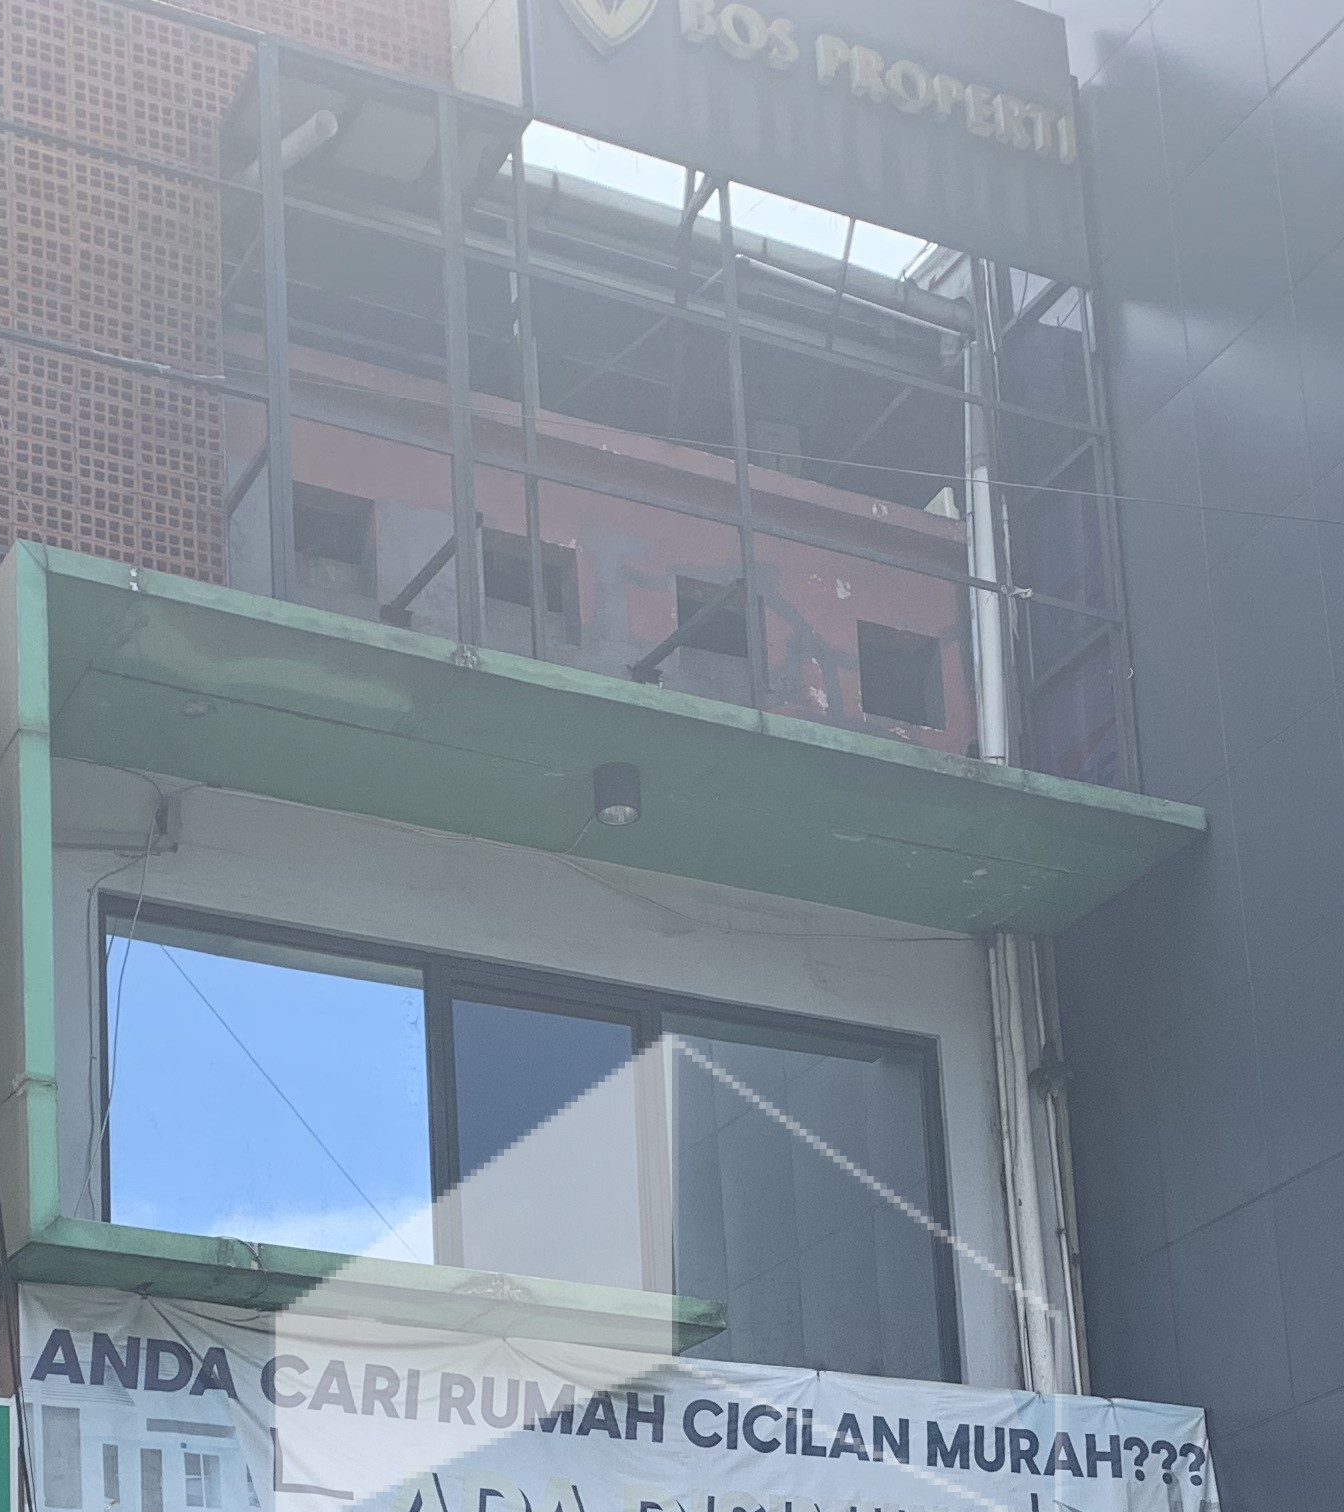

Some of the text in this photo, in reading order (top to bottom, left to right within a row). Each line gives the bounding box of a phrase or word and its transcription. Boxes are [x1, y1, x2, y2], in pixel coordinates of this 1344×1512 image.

[679, 0, 1077, 165] BOS PROPERTI
[32, 1329, 241, 1400] ANDA
[260, 1350, 421, 1422] CARI
[449, 1369, 666, 1448] RUMAH
[923, 1420, 1209, 1492] MURAH???
